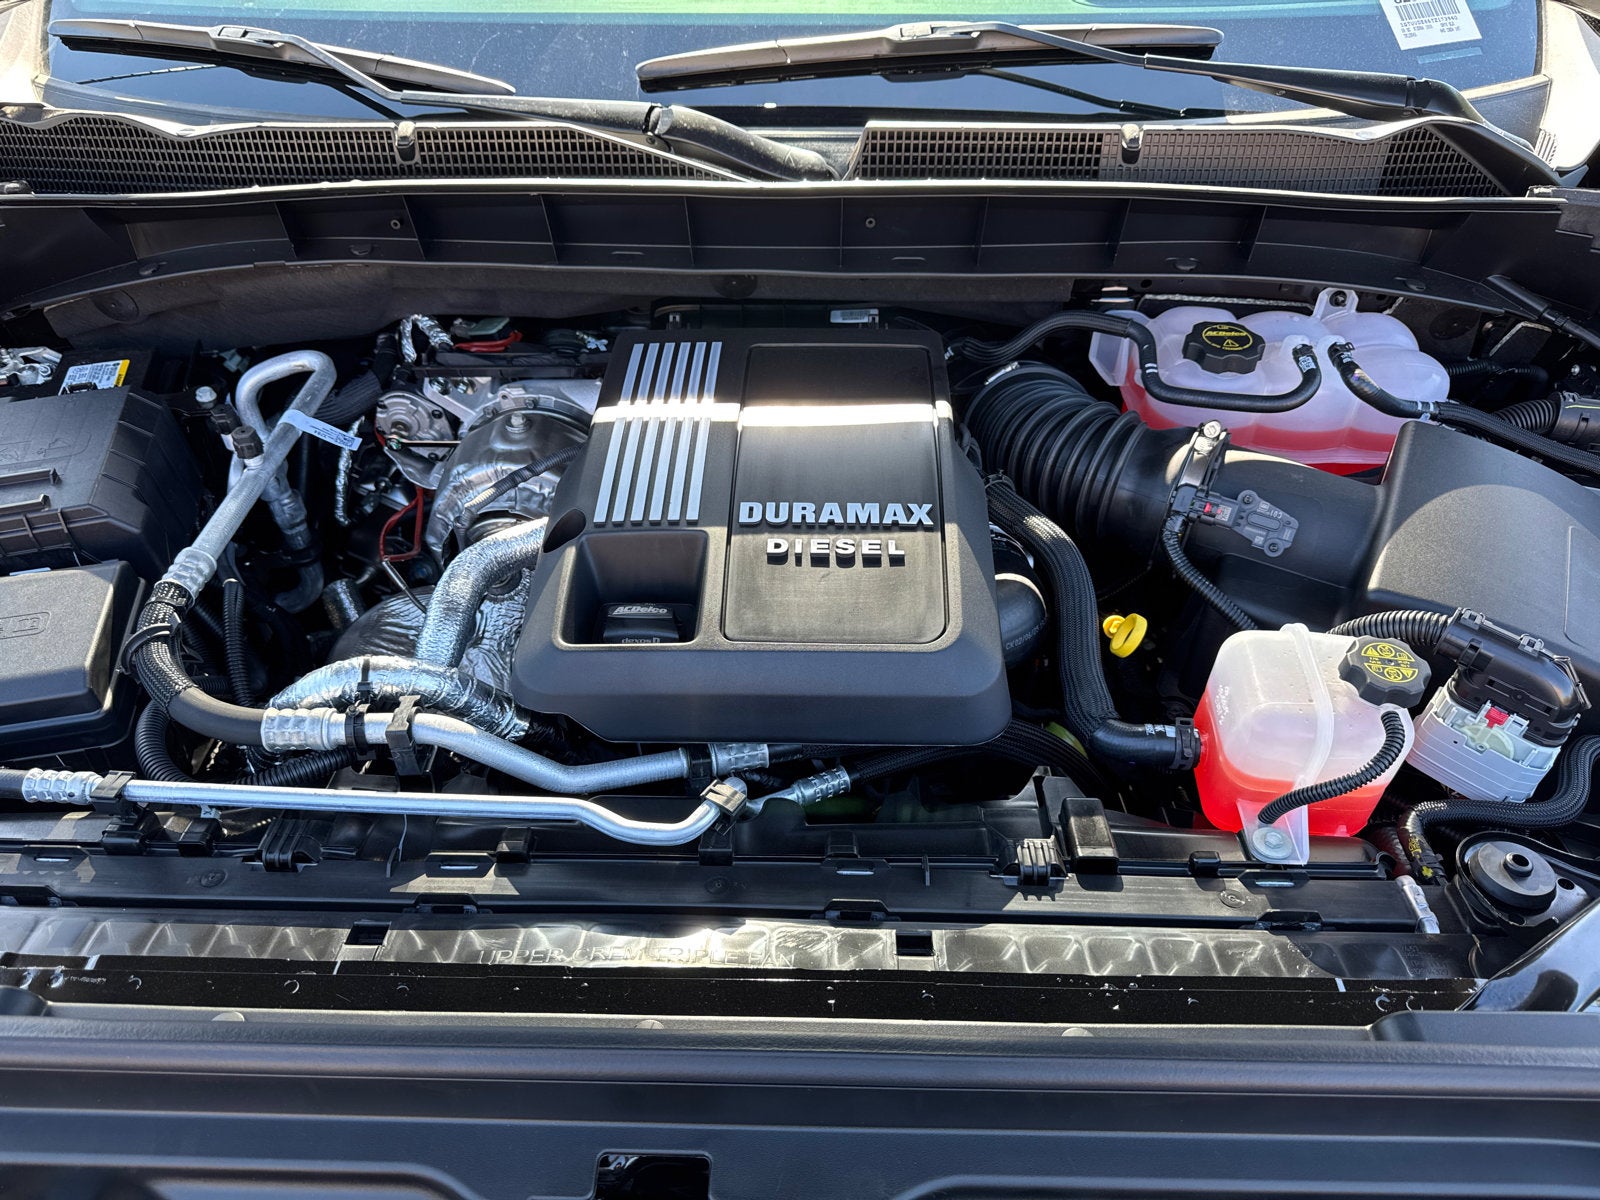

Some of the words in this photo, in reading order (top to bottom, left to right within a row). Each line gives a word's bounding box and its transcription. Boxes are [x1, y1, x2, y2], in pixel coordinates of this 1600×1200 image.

[738, 501, 934, 530] DURAMAX
[766, 538, 905, 556] DIESEL
[612, 605, 668, 615] ACDelco
[478, 948, 563, 965] UPPER
[748, 950, 795, 967] FAN
